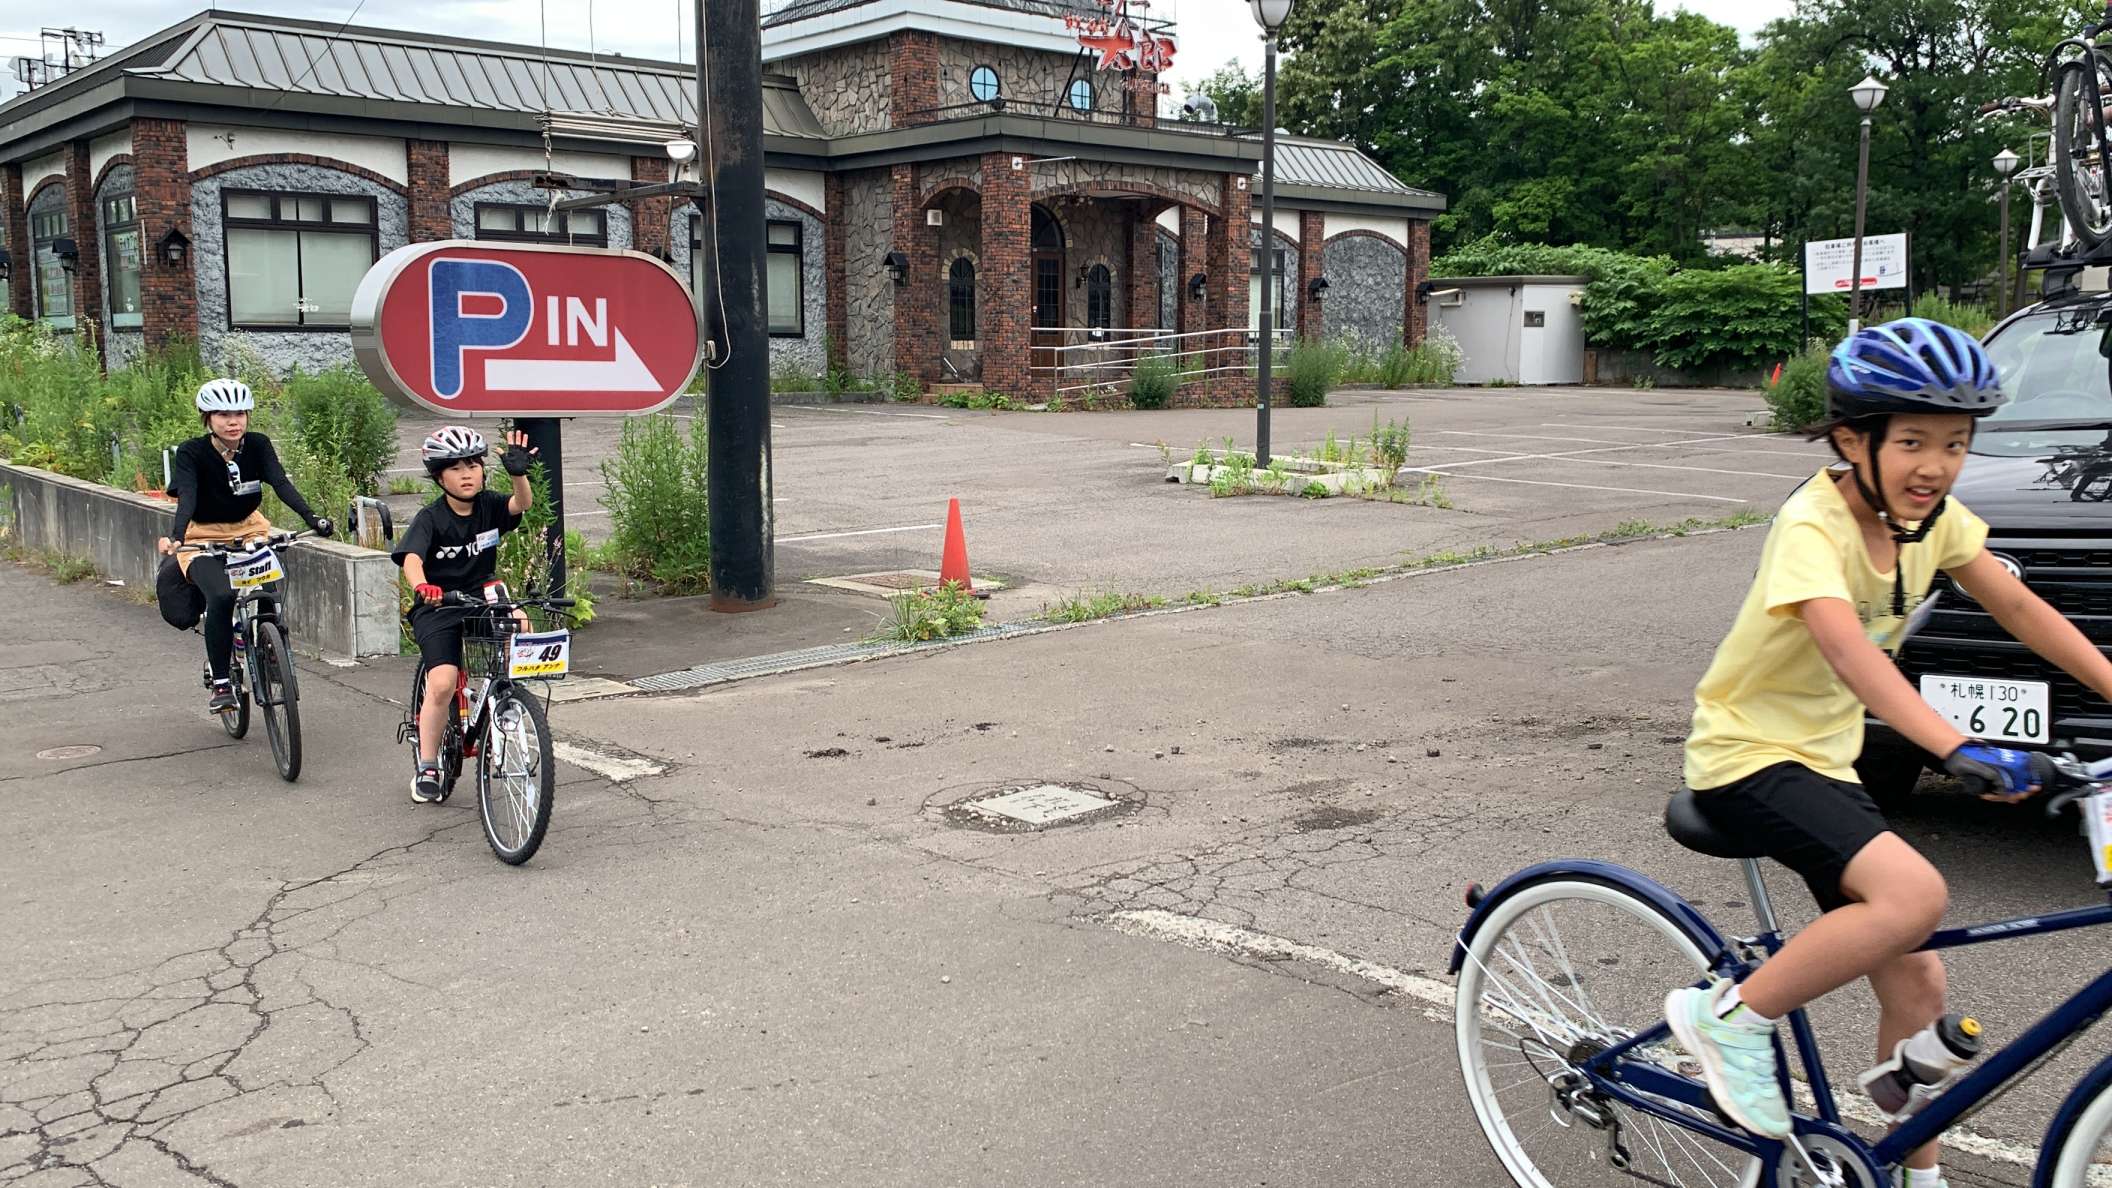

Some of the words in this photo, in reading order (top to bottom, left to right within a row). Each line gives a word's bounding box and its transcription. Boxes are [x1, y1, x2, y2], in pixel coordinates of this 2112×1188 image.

[428, 257, 535, 400] P
[547, 296, 608, 347] IN
[248, 560, 271, 577] Staff
[538, 644, 562, 662] 49
[1950, 682, 1984, 700] 札幌
[1990, 685, 2018, 702] 130
